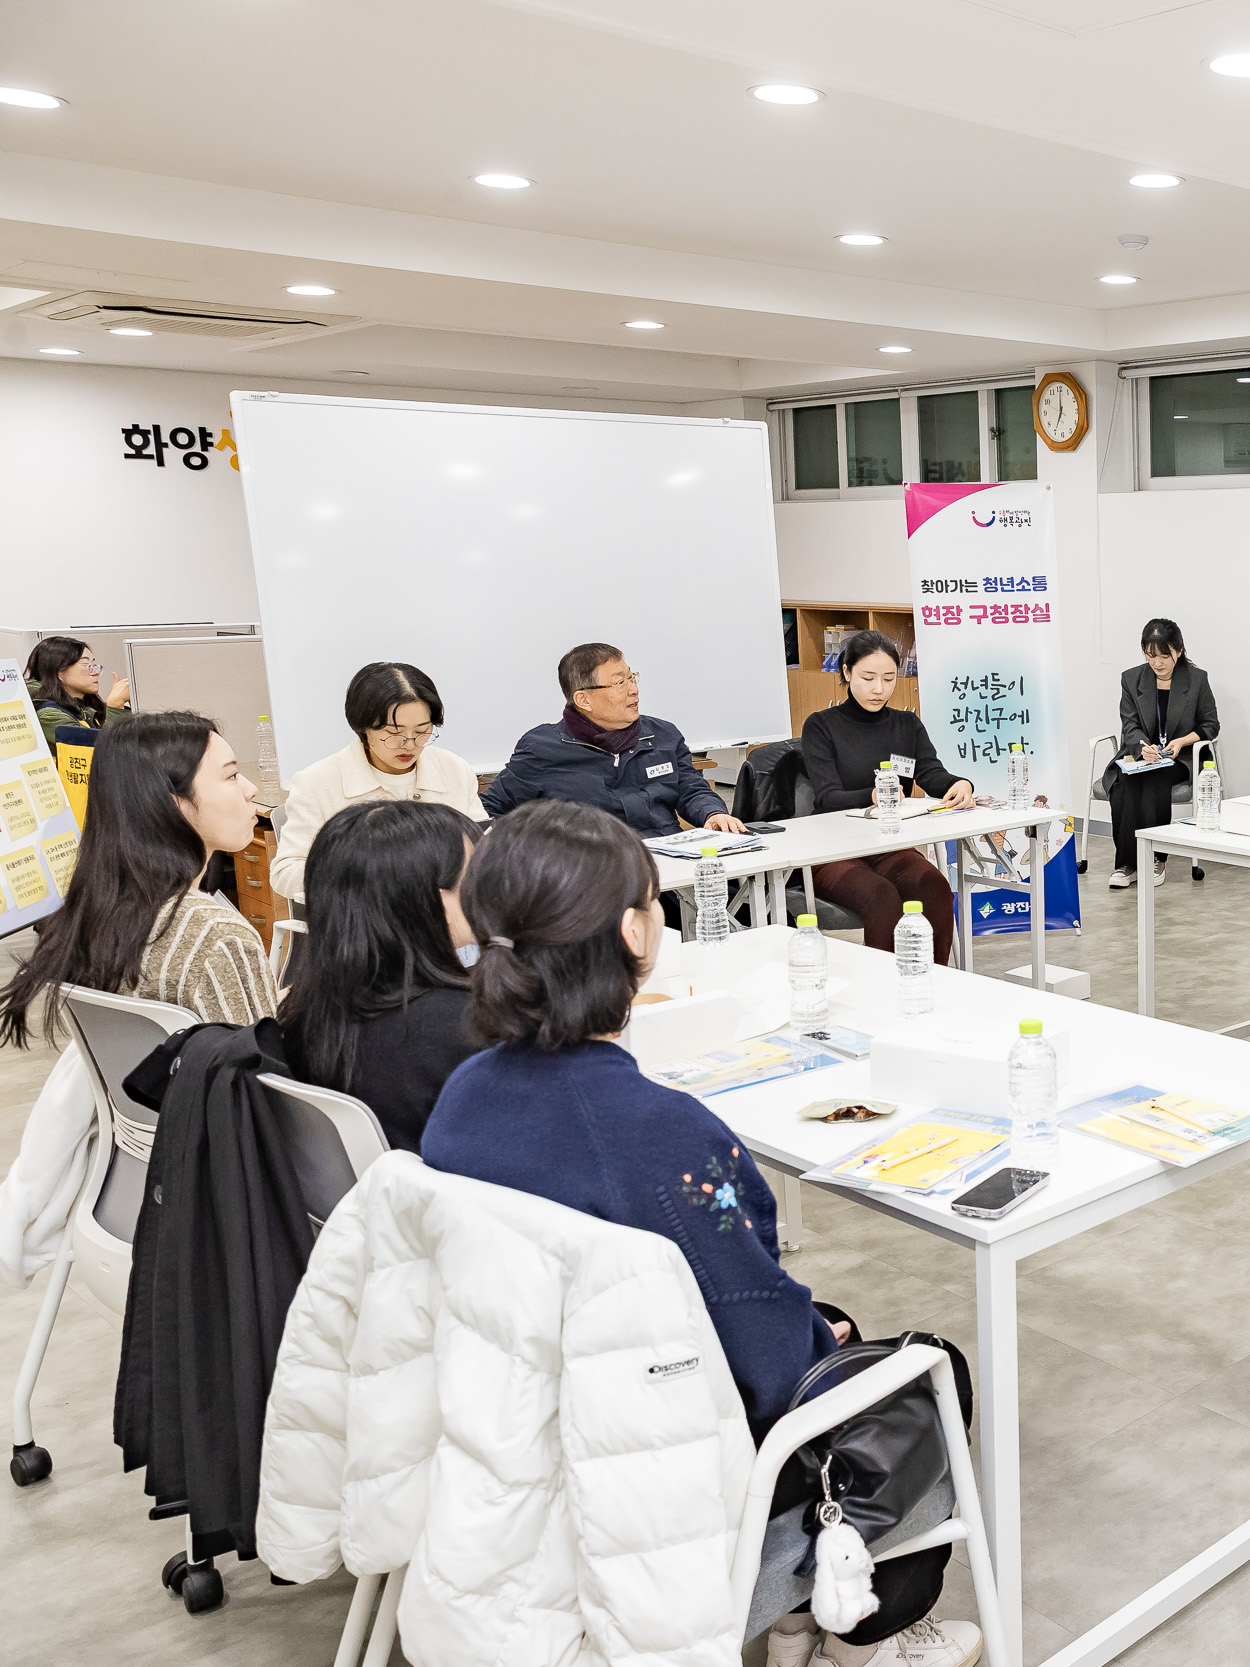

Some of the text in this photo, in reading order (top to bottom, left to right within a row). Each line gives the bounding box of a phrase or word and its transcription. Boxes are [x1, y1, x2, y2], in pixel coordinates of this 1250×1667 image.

[121, 424, 239, 471] 화양
[998, 516, 1032, 528] 행복광진
[921, 575, 1048, 594] 찾아가는 청년소통
[921, 602, 1051, 626] 현장 구청장실
[950, 672, 1024, 701] 청년들이
[949, 703, 1030, 733] 광진구에
[1001, 901, 1032, 915] 광진
